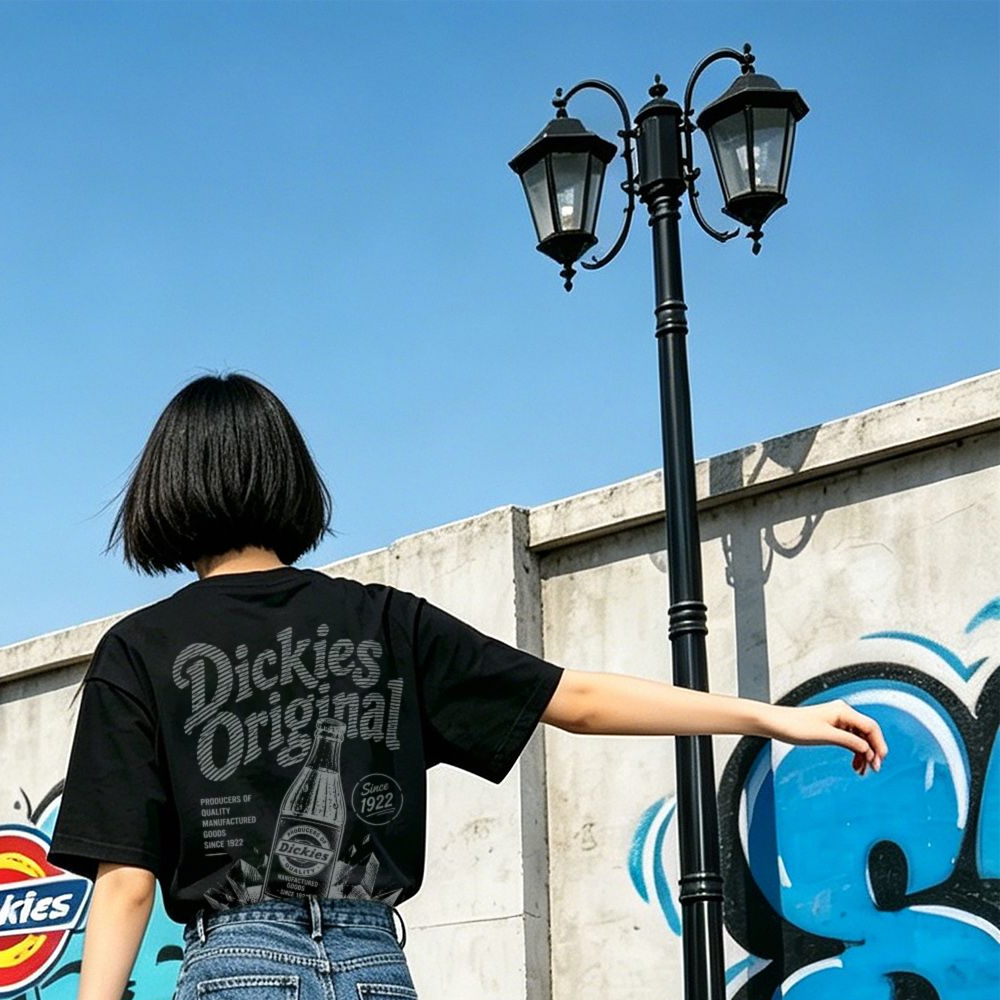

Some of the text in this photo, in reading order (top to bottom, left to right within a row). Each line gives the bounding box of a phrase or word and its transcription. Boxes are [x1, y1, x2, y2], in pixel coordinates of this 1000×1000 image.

[172, 624, 383, 736] Dickies
[196, 677, 404, 782] Original
[360, 782, 389, 796] Since
[200, 794, 252, 806] PRODUCERS OF
[360, 792, 394, 814] 1922
[201, 807, 231, 817] QUALITY
[202, 815, 257, 828] MANUFACTURED
[203, 829, 227, 839] GOODS
[287, 827, 321, 838] PRODUCERS
[204, 838, 244, 850] SINCE 1922
[278, 842, 330, 861] Dickies
[284, 862, 316, 875] QUALITY
[277, 874, 319, 888] MANUFACTURED
[286, 882, 306, 891] GOODS
